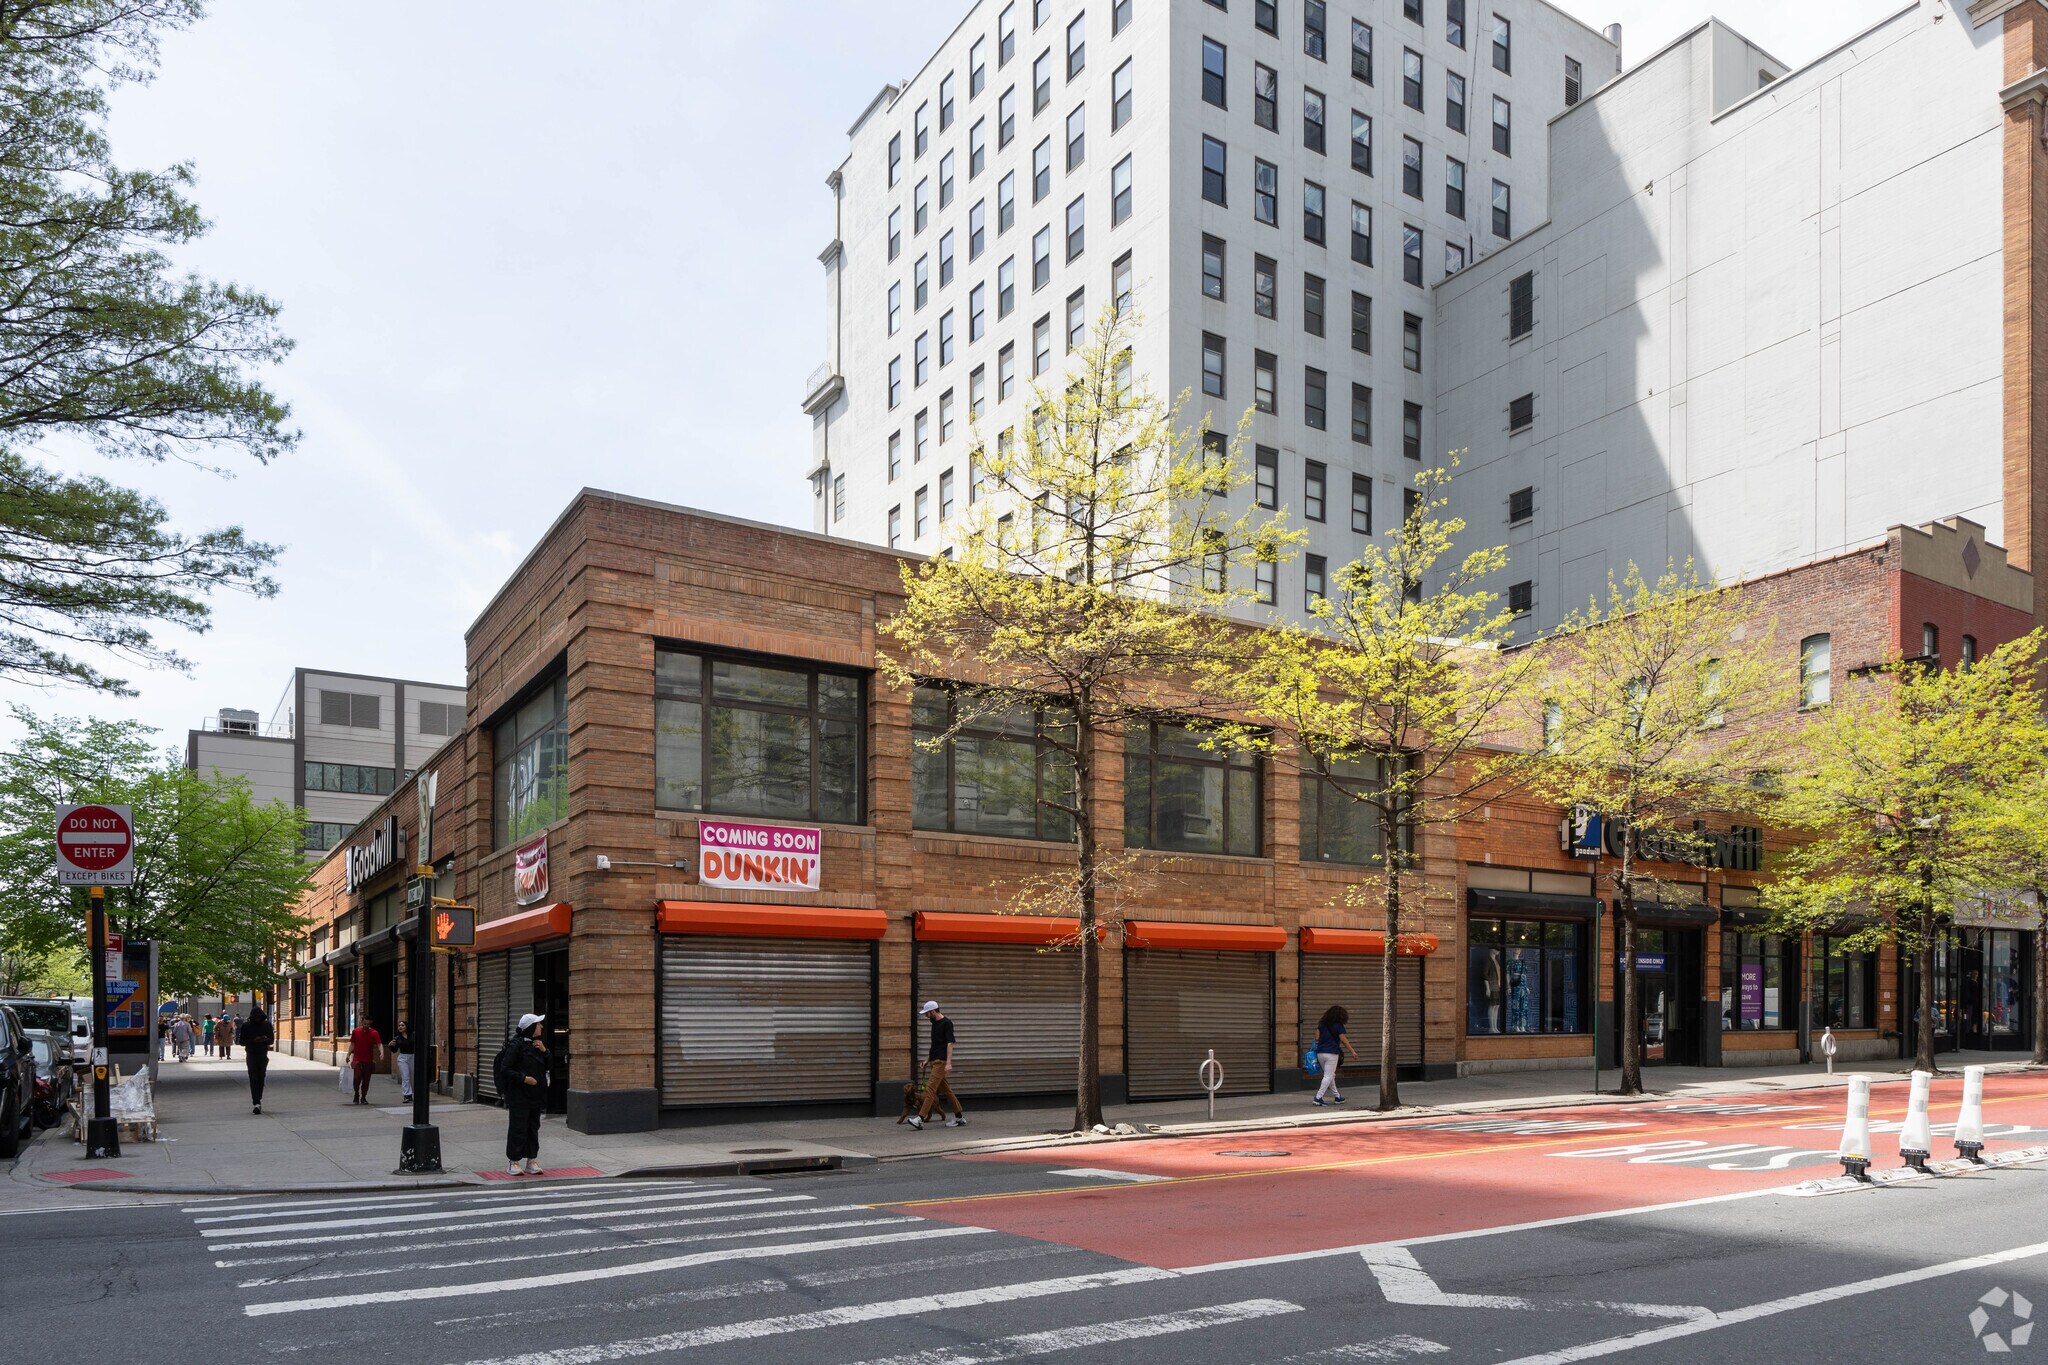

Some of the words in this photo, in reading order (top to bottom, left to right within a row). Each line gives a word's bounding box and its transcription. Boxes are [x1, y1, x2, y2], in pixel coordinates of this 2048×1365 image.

[70, 818, 88, 829] DO
[93, 818, 117, 829] NOT
[703, 826, 769, 847] COMING
[773, 832, 816, 851] SOON
[74, 847, 115, 858] ENTER
[352, 815, 393, 887] Goodwill
[66, 872, 98, 880] EXCEPT
[101, 872, 125, 880] BIKES
[703, 851, 816, 886] DUNKIN'
[1741, 973, 1757, 981] MORE
[1543, 1139, 1844, 1171] BUS
